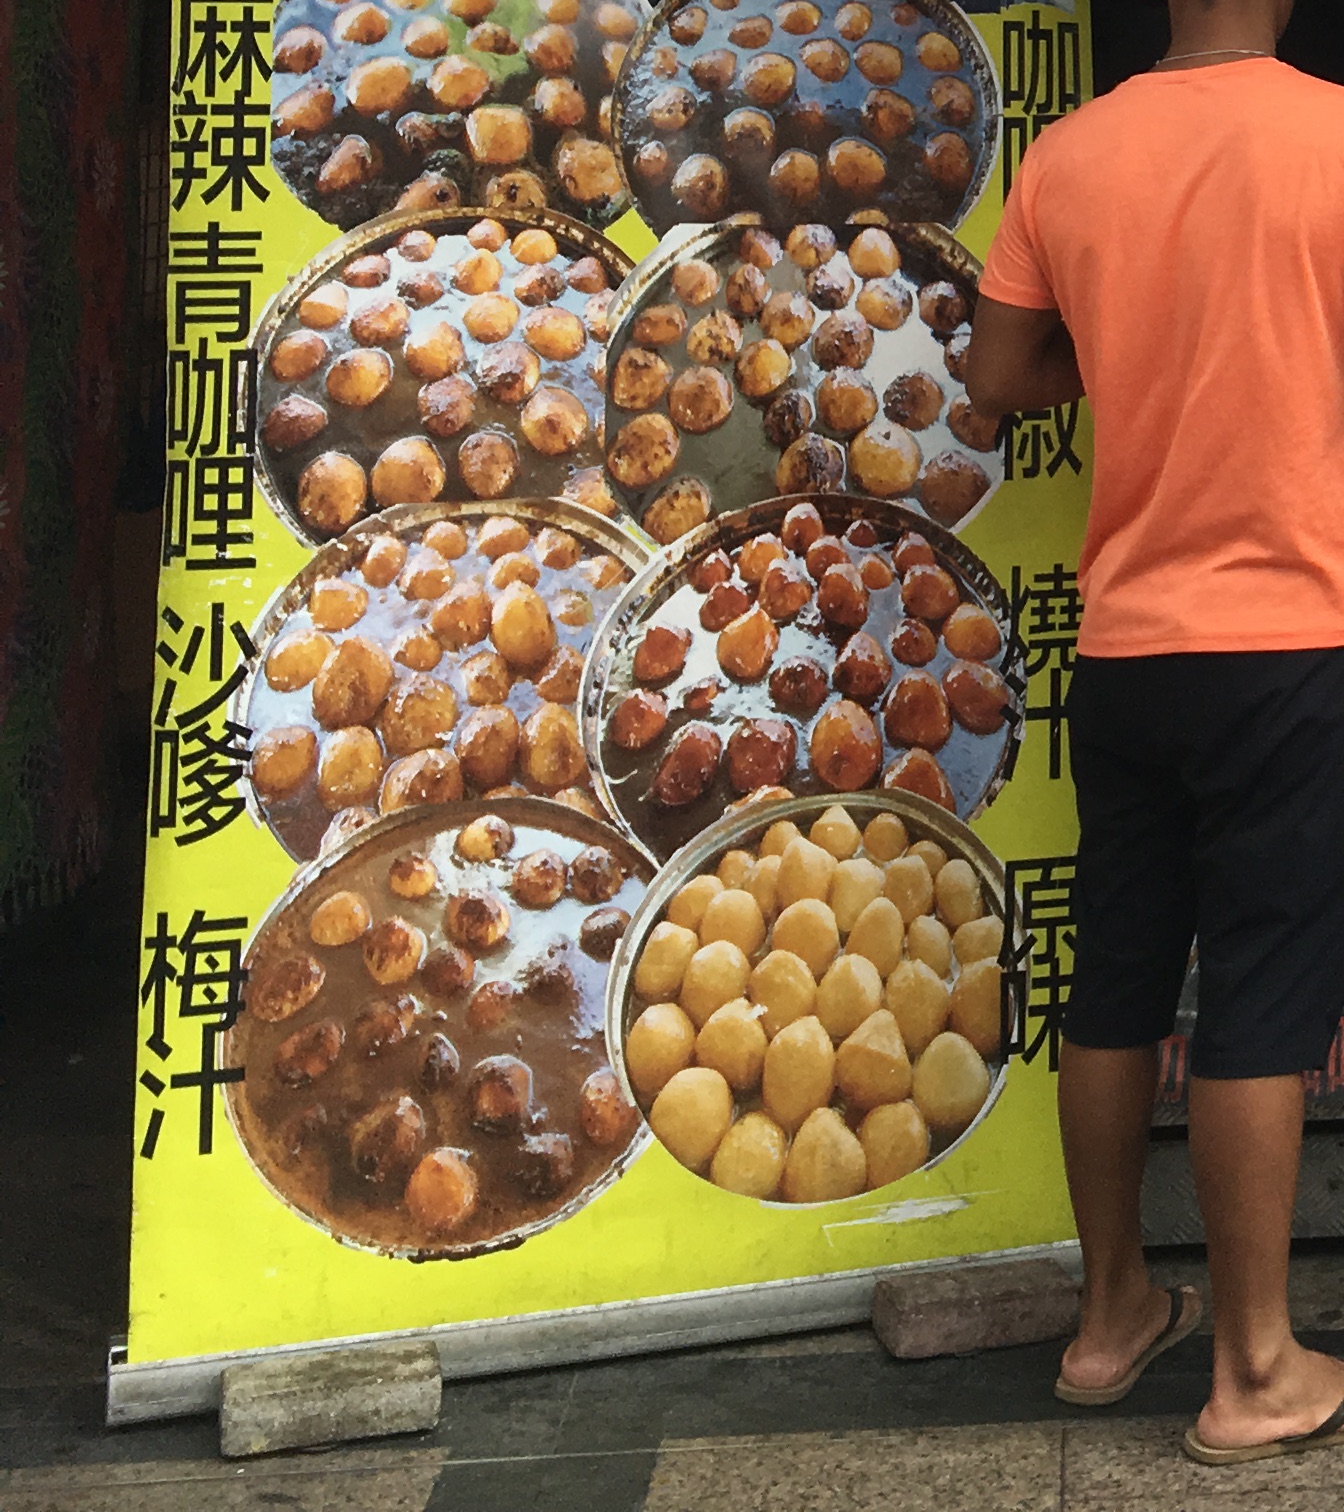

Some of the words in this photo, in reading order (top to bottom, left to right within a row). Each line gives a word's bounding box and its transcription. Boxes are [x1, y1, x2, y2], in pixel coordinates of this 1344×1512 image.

[161, 220, 265, 571] 青咖哩
[148, 601, 258, 849] 沙嗲
[138, 909, 250, 1161] 梅汁
